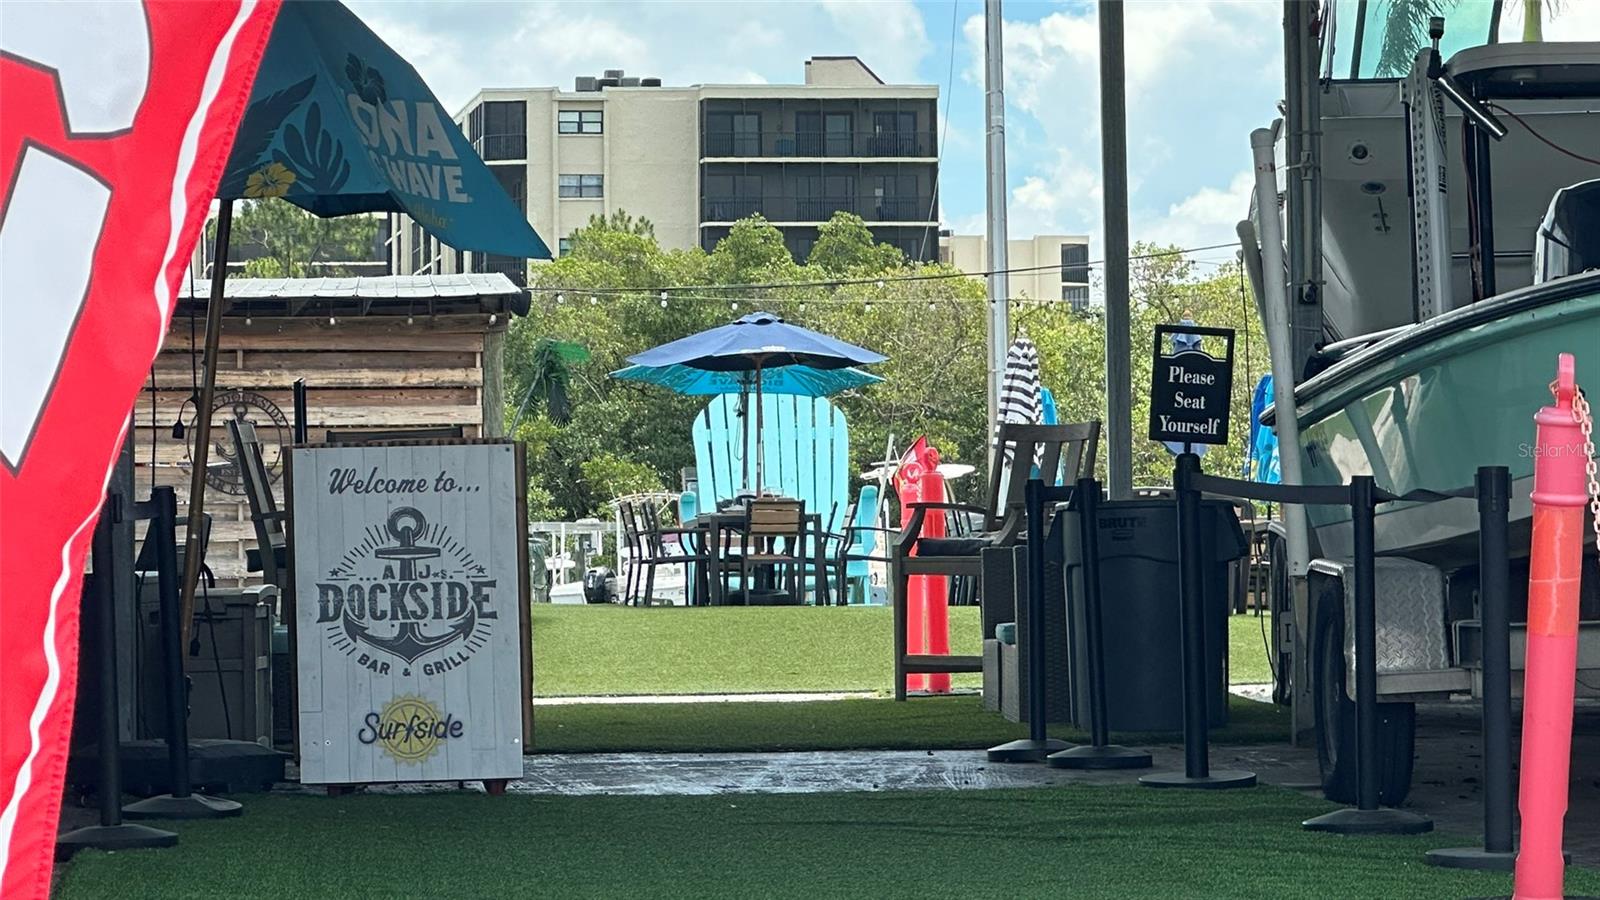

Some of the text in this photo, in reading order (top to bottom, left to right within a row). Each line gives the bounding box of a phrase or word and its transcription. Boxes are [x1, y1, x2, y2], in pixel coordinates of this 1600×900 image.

[346, 94, 459, 160] ONA
[1168, 366, 1215, 386] Please
[1174, 391, 1206, 410] Seat
[1159, 415, 1220, 435] Yourself
[329, 466, 429, 495] Welcome
[315, 579, 498, 624] DOCKSIDE
[357, 651, 470, 677] BAR & GRILL
[358, 711, 464, 745] Surfside
